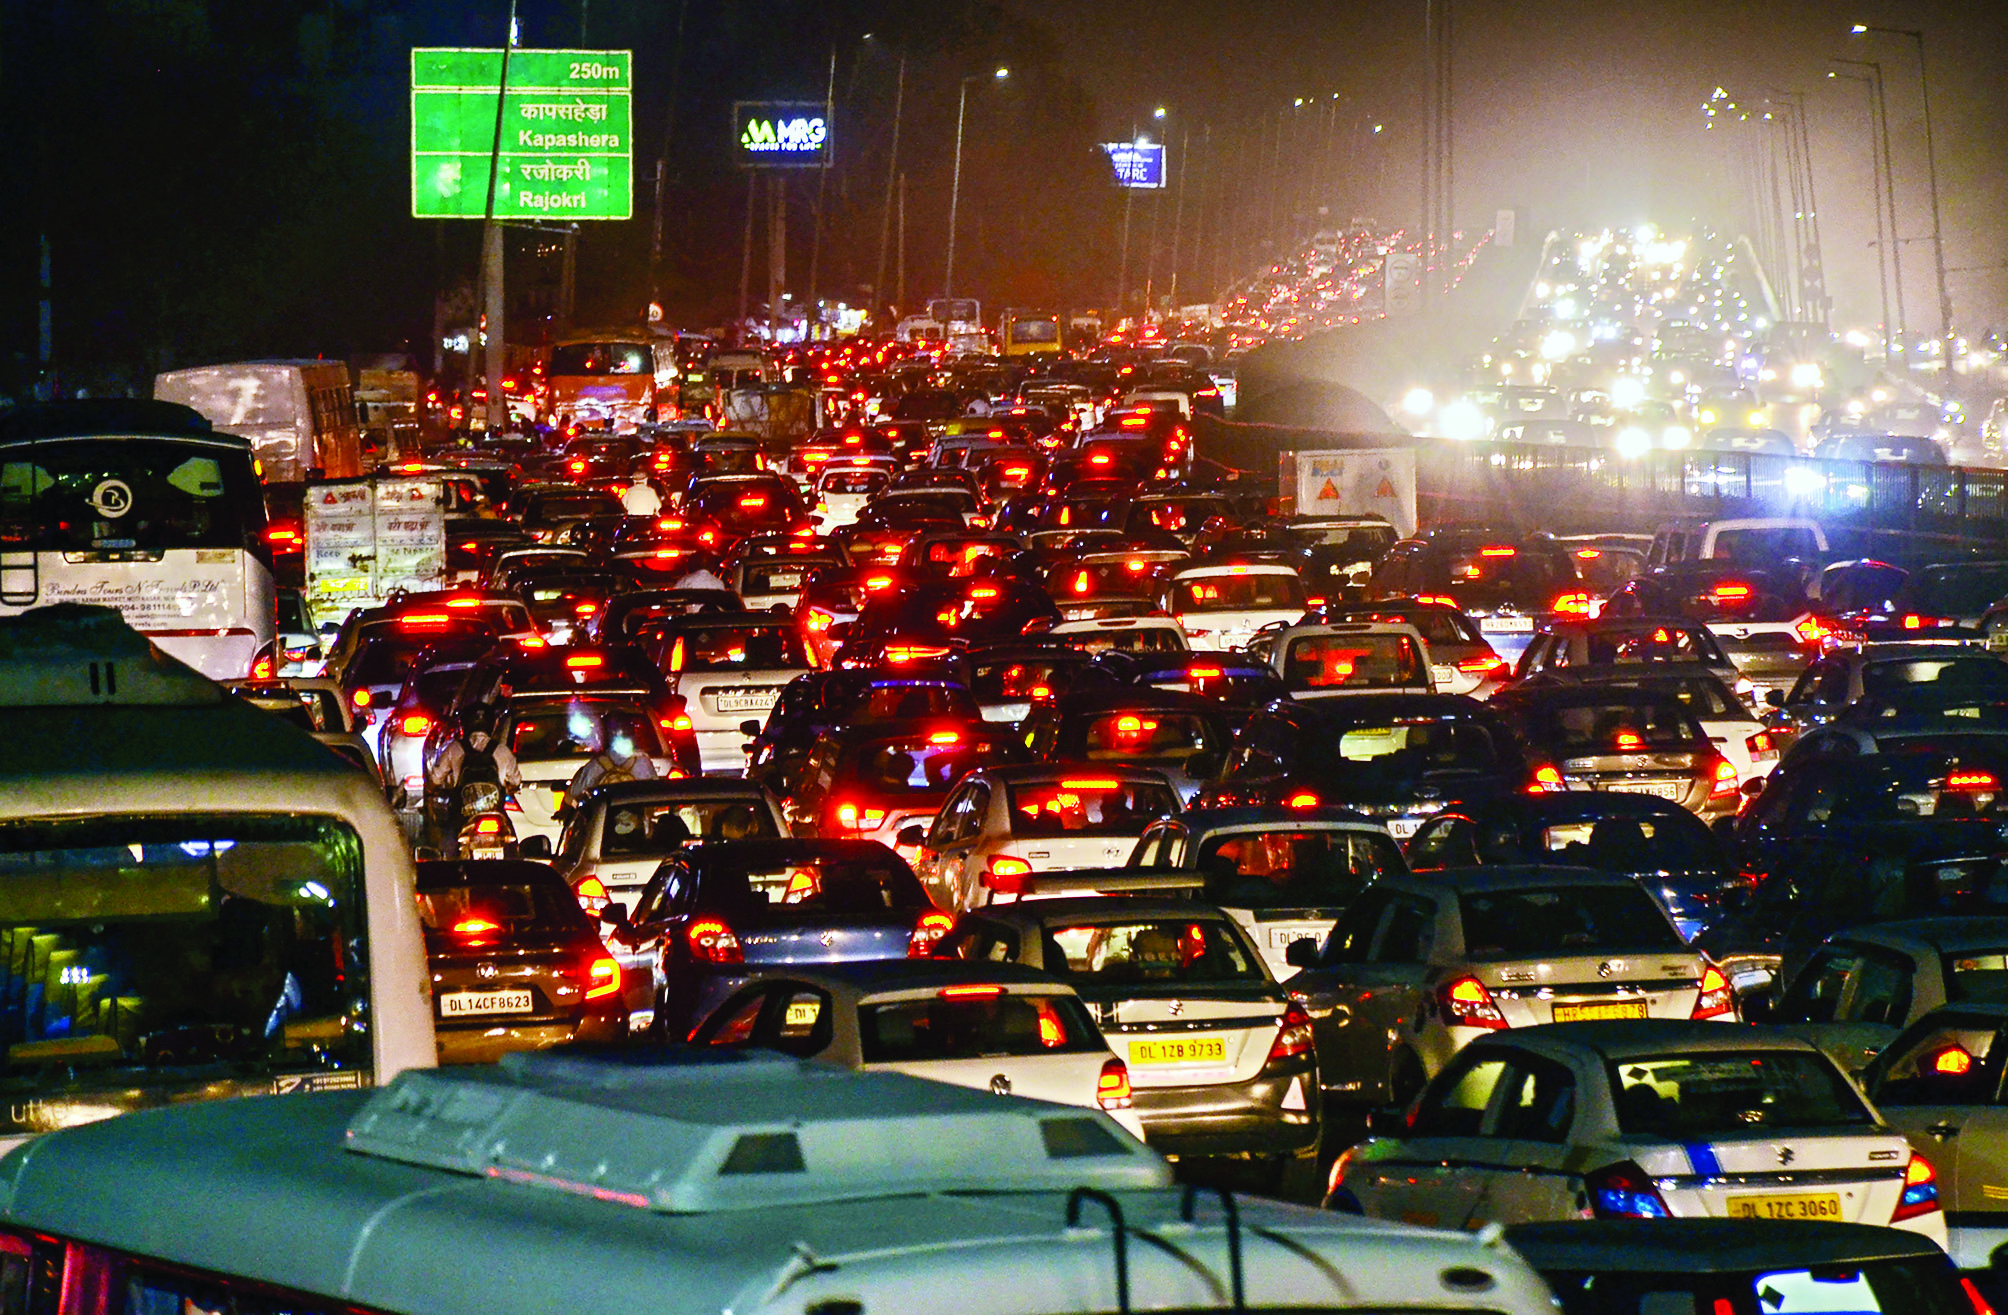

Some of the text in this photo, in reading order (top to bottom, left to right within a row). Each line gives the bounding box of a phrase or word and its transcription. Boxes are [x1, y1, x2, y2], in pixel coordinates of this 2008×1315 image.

[569, 62, 619, 79] 250m
[520, 98, 607, 124] कापसहेड़ा
[519, 130, 619, 150] Kapashera
[520, 158, 591, 181] रजोकरी
[519, 191, 586, 211] Rajokri
[1140, 1046, 1156, 1059] DL
[1188, 1042, 1222, 1057] 9733
[1742, 1203, 1758, 1217] DL
[1799, 1199, 1838, 1216] 3060
